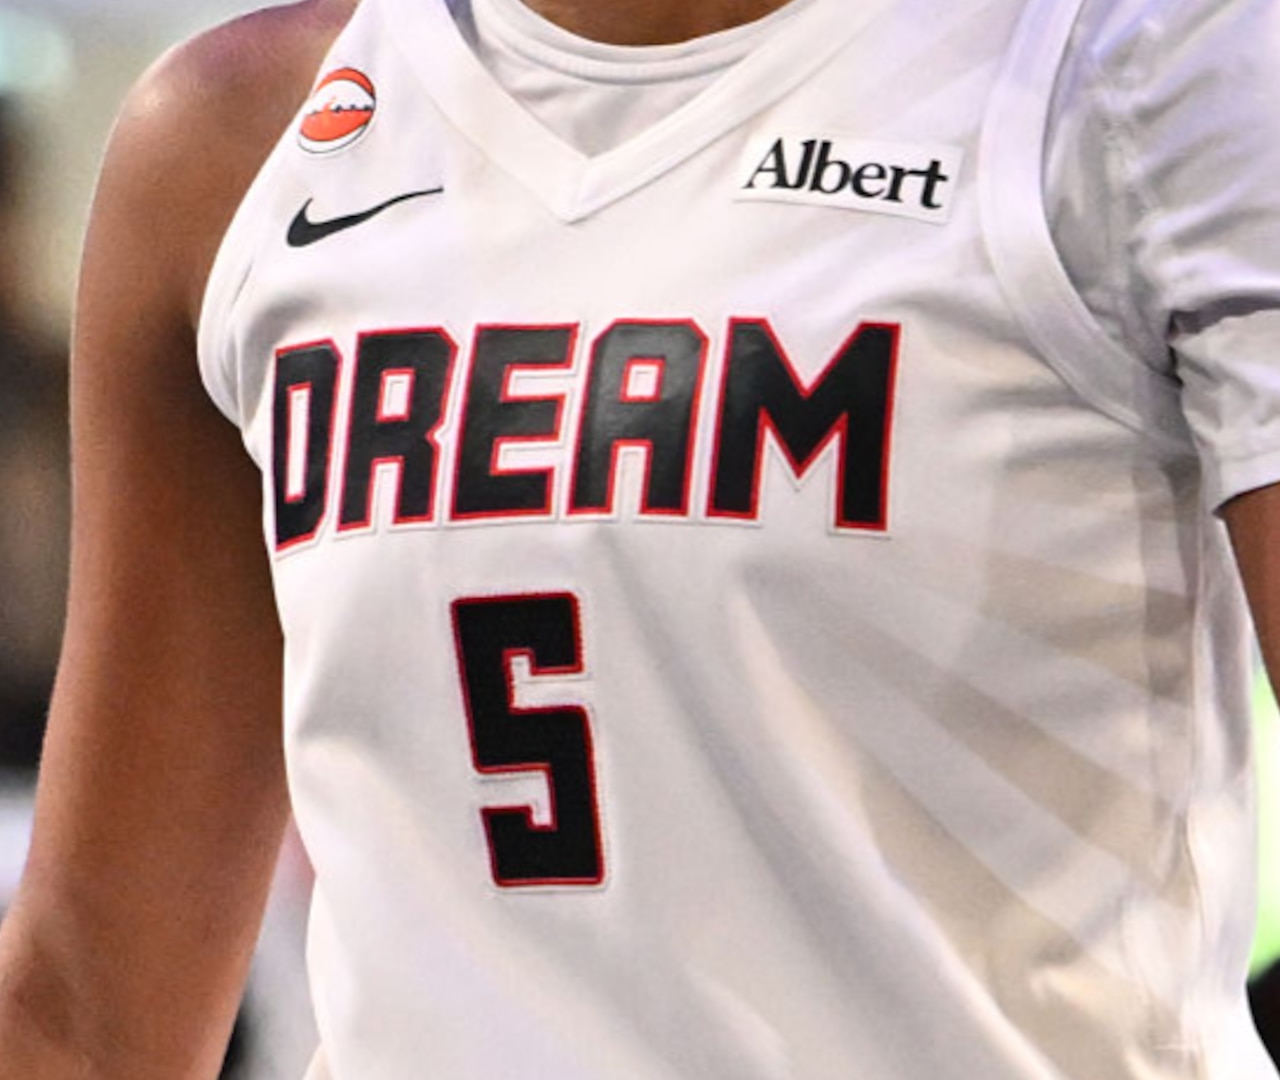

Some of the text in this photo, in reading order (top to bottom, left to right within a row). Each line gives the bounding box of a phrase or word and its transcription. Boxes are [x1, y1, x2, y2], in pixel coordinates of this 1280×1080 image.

[741, 136, 949, 210] Albert
[273, 317, 900, 551] DREAM
[450, 591, 606, 888] 5
